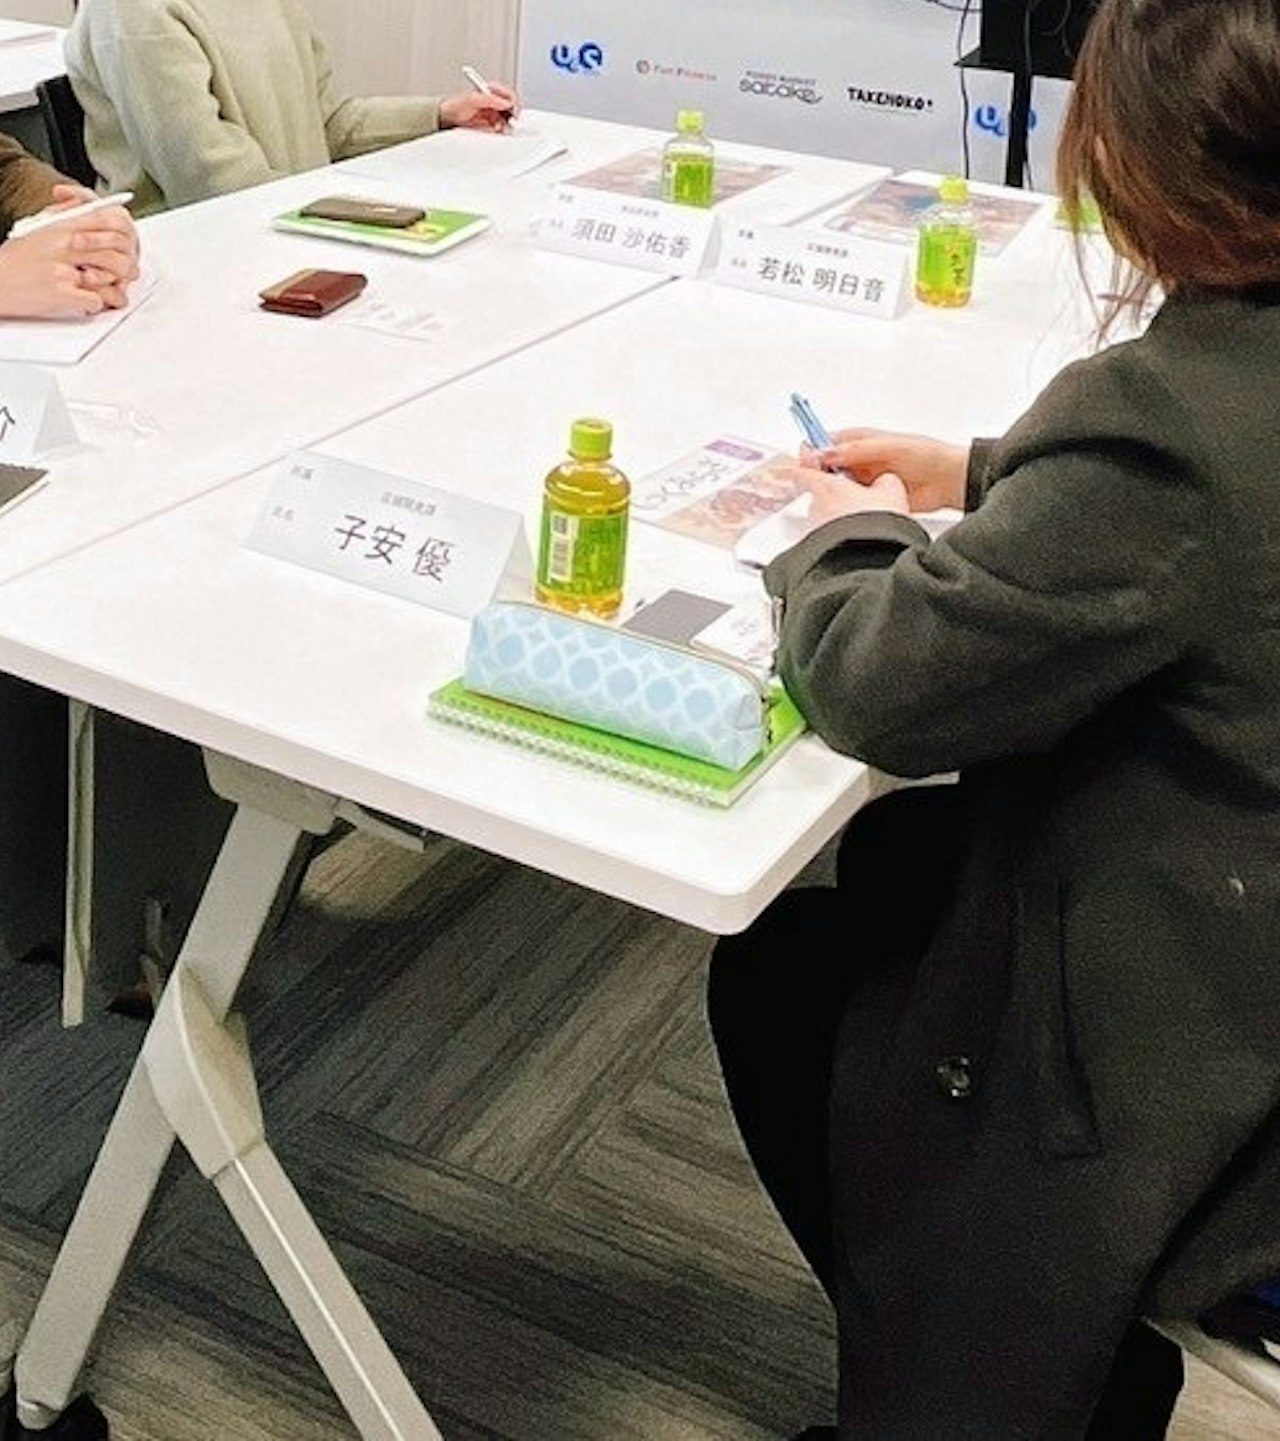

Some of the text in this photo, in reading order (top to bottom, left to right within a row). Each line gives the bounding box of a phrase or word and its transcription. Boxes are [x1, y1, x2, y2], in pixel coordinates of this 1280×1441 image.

[740, 78, 822, 104] satake
[758, 256, 885, 303] 若松 明日音
[334, 514, 455, 582] 子安 優
